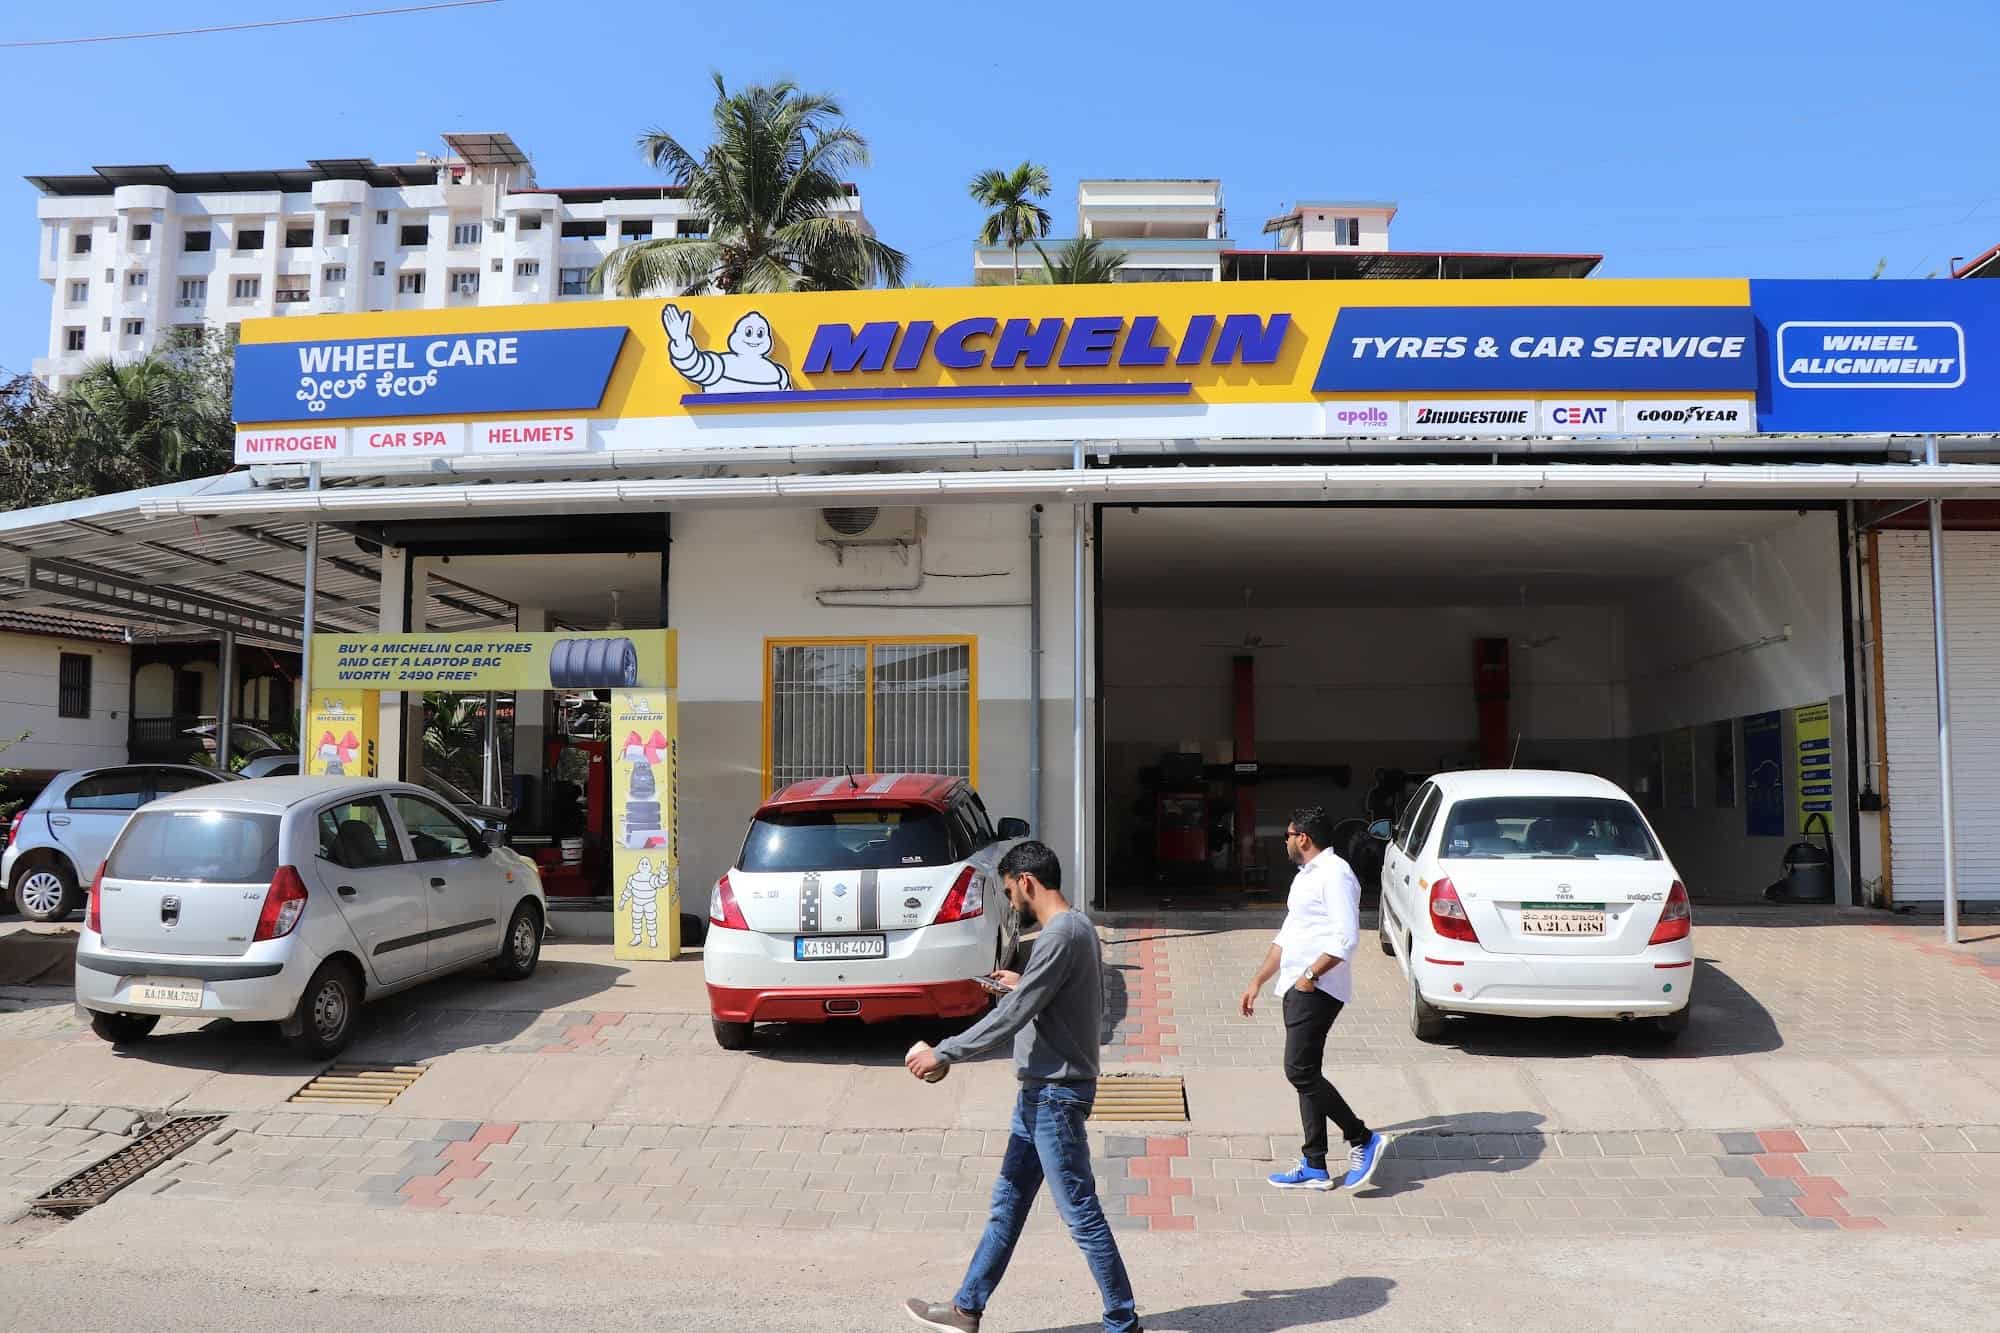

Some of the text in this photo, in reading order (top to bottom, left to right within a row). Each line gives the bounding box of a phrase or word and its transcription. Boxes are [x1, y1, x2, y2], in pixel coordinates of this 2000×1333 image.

[803, 313, 1292, 374] MICHELIN
[1350, 335, 1746, 360] TYRES & CAR SERVICE
[1822, 335, 1918, 352] WHEEL
[298, 337, 518, 374] WHEEL CARE
[1788, 357, 1955, 375] ALIGNMENT
[375, 369, 438, 397] ಕೇರ್
[1337, 407, 1388, 426] apollo
[1416, 408, 1528, 425] BRIDGESTONE
[1552, 407, 1607, 425] CEAT
[369, 431, 447, 449] CAR SPA
[488, 426, 574, 444] HELMETS
[246, 435, 337, 454] NITROGEN
[338, 643, 532, 654] BUY 4 MICHELIN CAR TYRES
[337, 657, 501, 667] AND GET A LAPTOP BAG
[338, 671, 390, 680] WORTH
